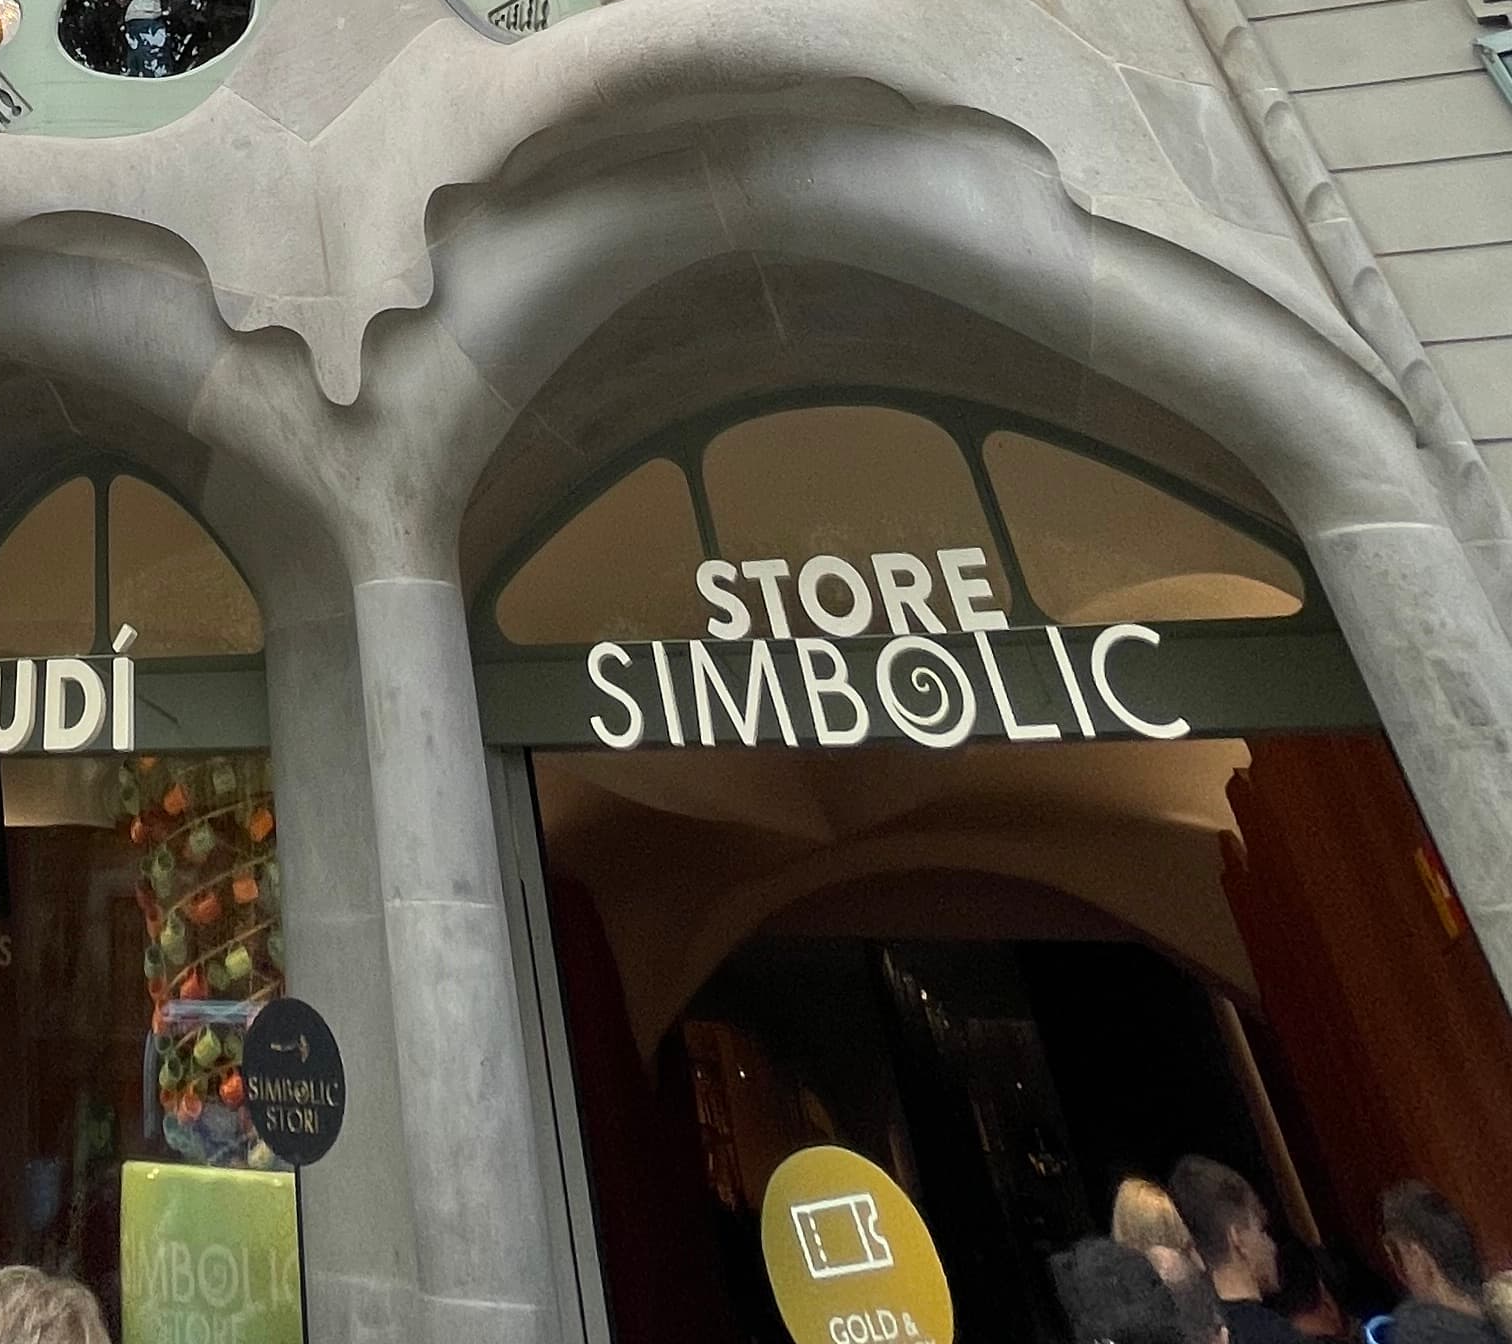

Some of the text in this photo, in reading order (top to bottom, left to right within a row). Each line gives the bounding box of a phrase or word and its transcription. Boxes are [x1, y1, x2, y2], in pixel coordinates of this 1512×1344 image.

[695, 547, 1009, 641] STORE
[587, 623, 1190, 749] SIMBOLIC
[248, 1075, 339, 1107] SIMBOLIC
[829, 1309, 898, 1344] GOLD
